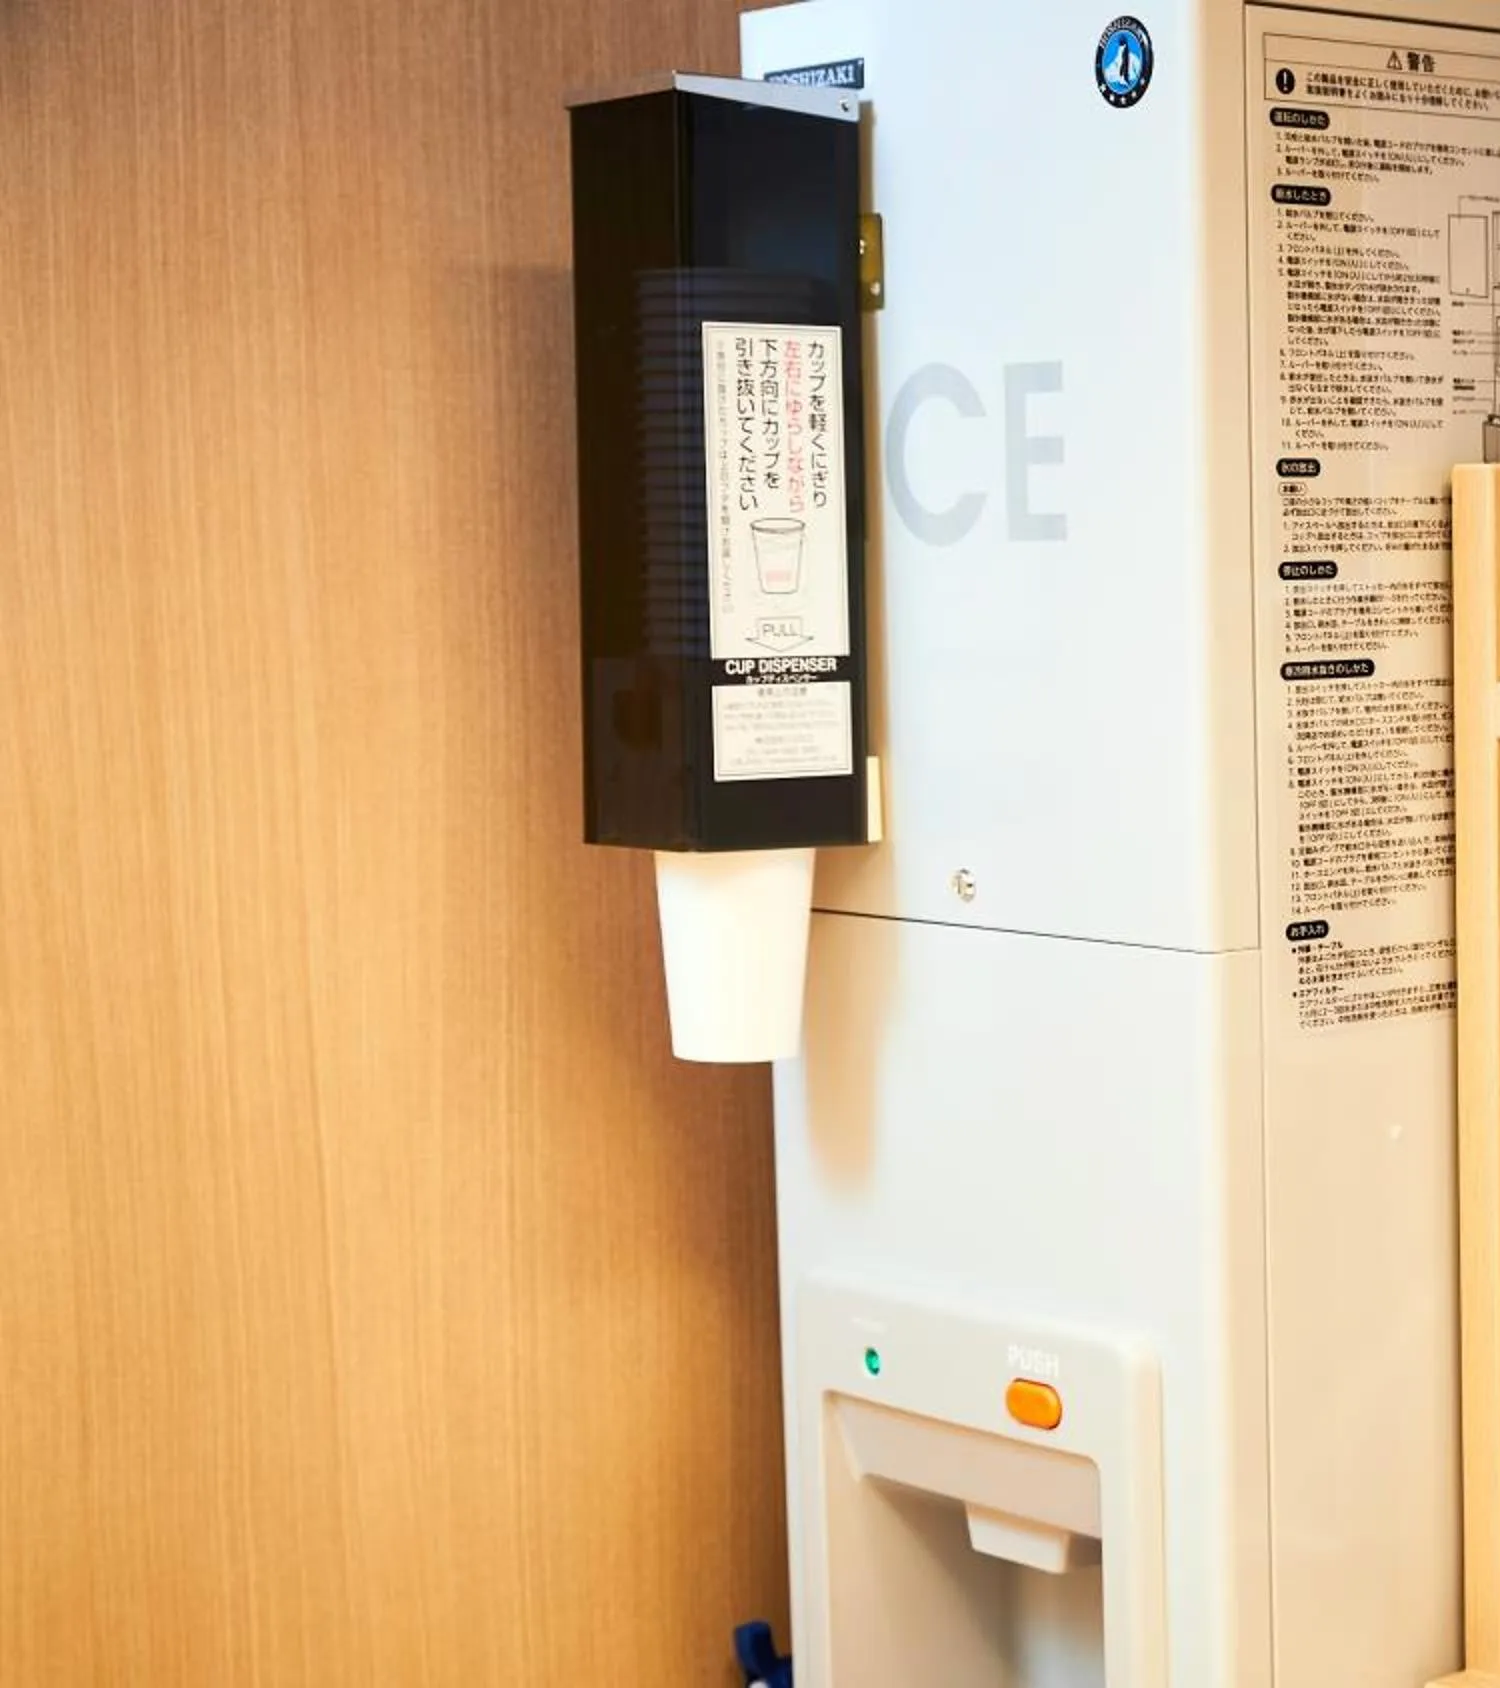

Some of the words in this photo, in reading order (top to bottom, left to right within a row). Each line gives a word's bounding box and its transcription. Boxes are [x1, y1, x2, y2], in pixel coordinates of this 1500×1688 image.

[736, 337, 759, 512] 引き抜いてください
[759, 338, 781, 490] 下方向にカップを
[784, 339, 806, 514] 左右にゆらしながら
[808, 341, 829, 509] カップを軽くにぎり
[725, 659, 755, 675] CUP
[758, 657, 837, 674] DISPENSER
[763, 623, 798, 638] PULL
[1007, 1344, 1060, 1378] PUSH
